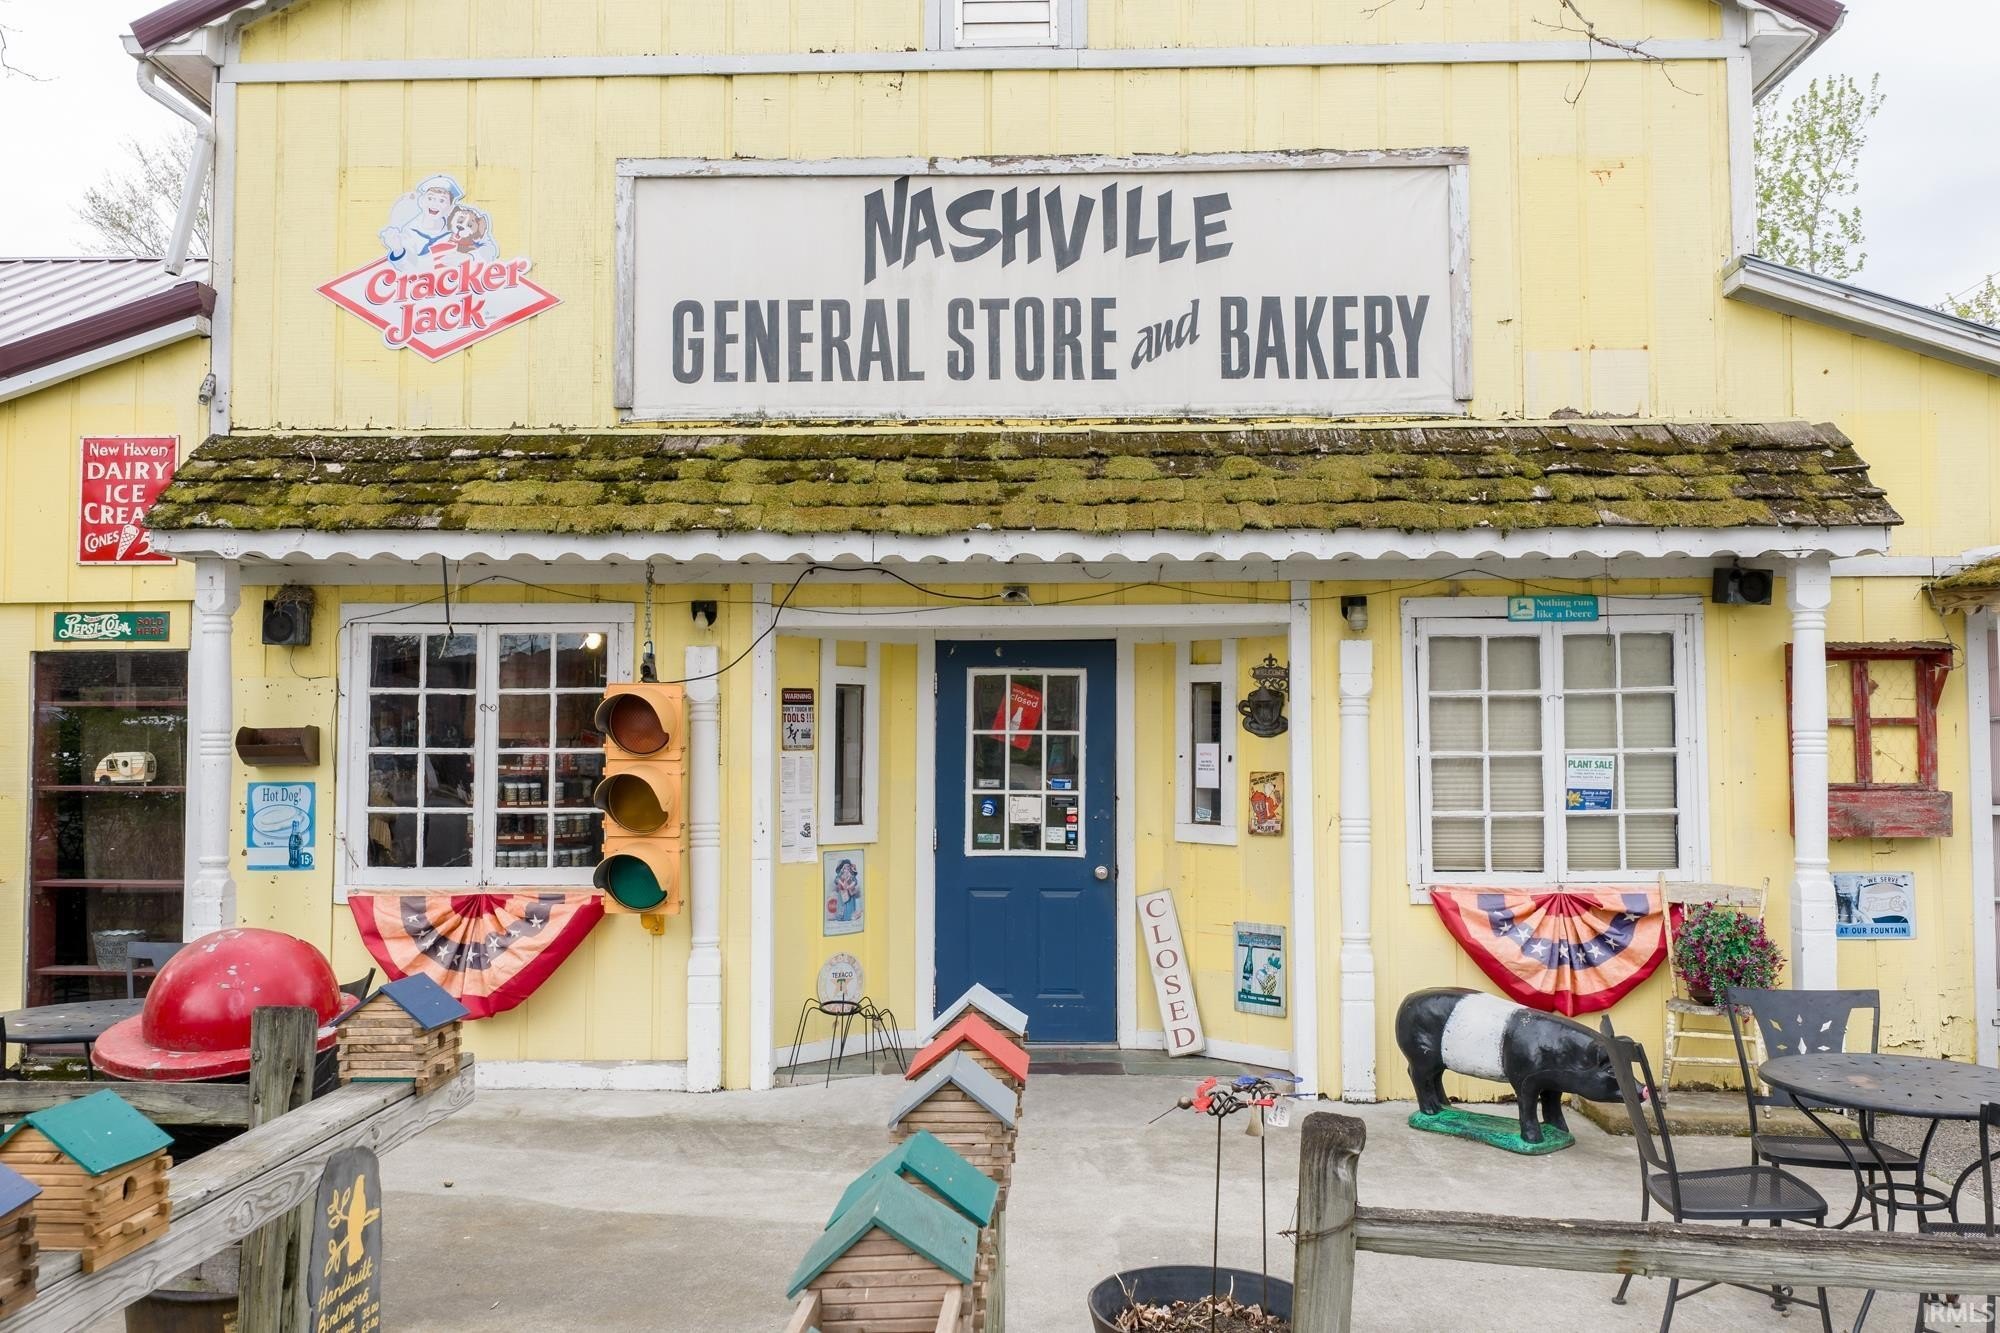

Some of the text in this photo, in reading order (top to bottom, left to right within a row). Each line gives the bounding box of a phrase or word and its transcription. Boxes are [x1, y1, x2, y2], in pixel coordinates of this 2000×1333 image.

[864, 175, 1233, 285] NASHVILLE
[365, 259, 528, 306] Cracker
[385, 294, 487, 344] Jack
[672, 295, 1430, 383] GENERAL STORE and BAKERY
[90, 442, 169, 457] New Haven
[87, 461, 170, 480] DAIRY
[106, 484, 146, 503] ICE
[84, 502, 150, 525] CREA
[1536, 599, 1571, 608] Nothing
[137, 617, 164, 625] SOLD
[1536, 610, 1553, 618] like
[1565, 610, 1592, 618] Deere
[137, 627, 164, 635] HERE
[1010, 694, 1038, 708] closed
[1568, 760, 1613, 769] PLANT SALE
[262, 787, 302, 805] Hot Dog!
[1880, 876, 1899, 884] SERVE
[1146, 898, 1195, 1048] CLOSED
[319, 1256, 373, 1313] Handbuilt
[318, 1287, 370, 1333] Birdhouses
